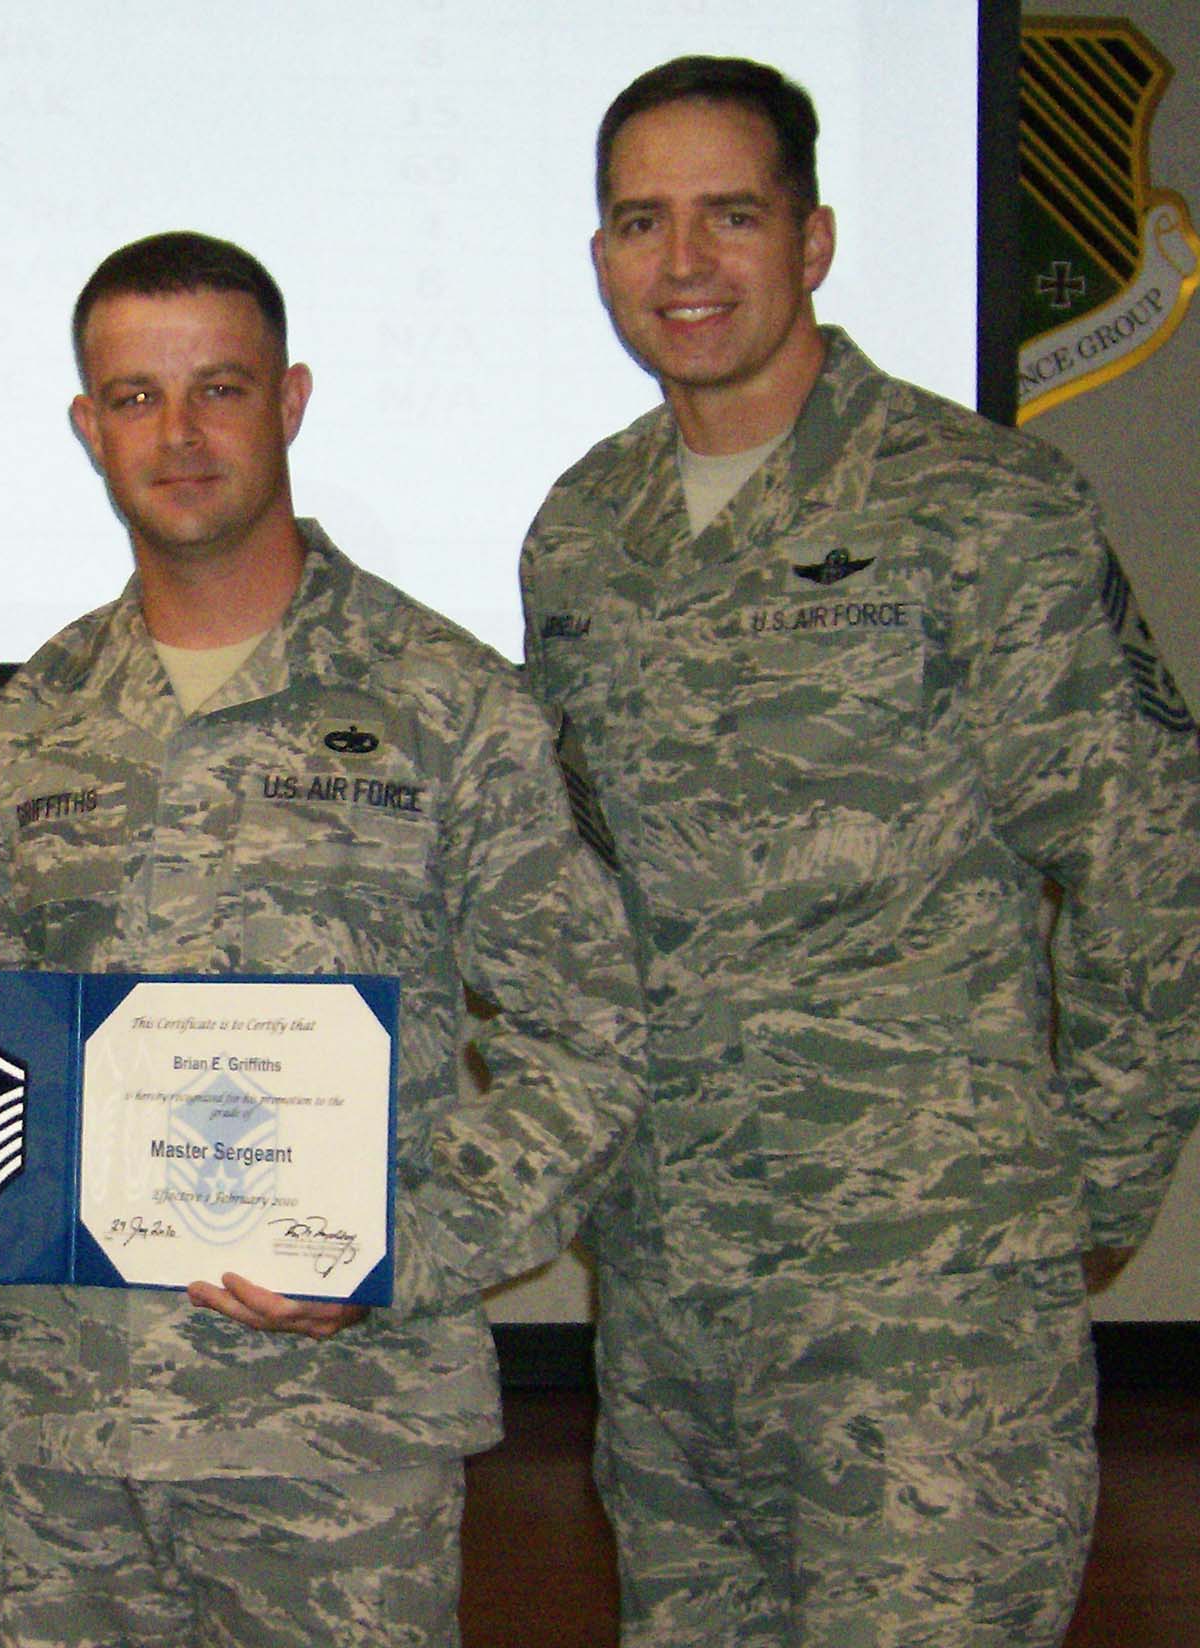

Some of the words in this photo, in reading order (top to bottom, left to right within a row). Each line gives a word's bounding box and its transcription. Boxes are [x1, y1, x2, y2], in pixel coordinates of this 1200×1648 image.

[1078, 287, 1162, 359] GROUP
[785, 606, 827, 630] AIR
[832, 602, 908, 628] FORCE
[308, 776, 348, 801] AIR
[353, 778, 423, 812] FORCE
[132, 1016, 154, 1030] This
[157, 1017, 216, 1033] Certificate
[232, 1019, 244, 1030] to
[247, 1018, 288, 1033] Certify
[290, 1018, 316, 1031] that
[173, 1056, 208, 1071] Brian
[228, 1057, 282, 1073] Griffiths
[151, 1140, 209, 1160] Master
[213, 1142, 292, 1166] Sergeant
[211, 1191, 269, 1209] February
